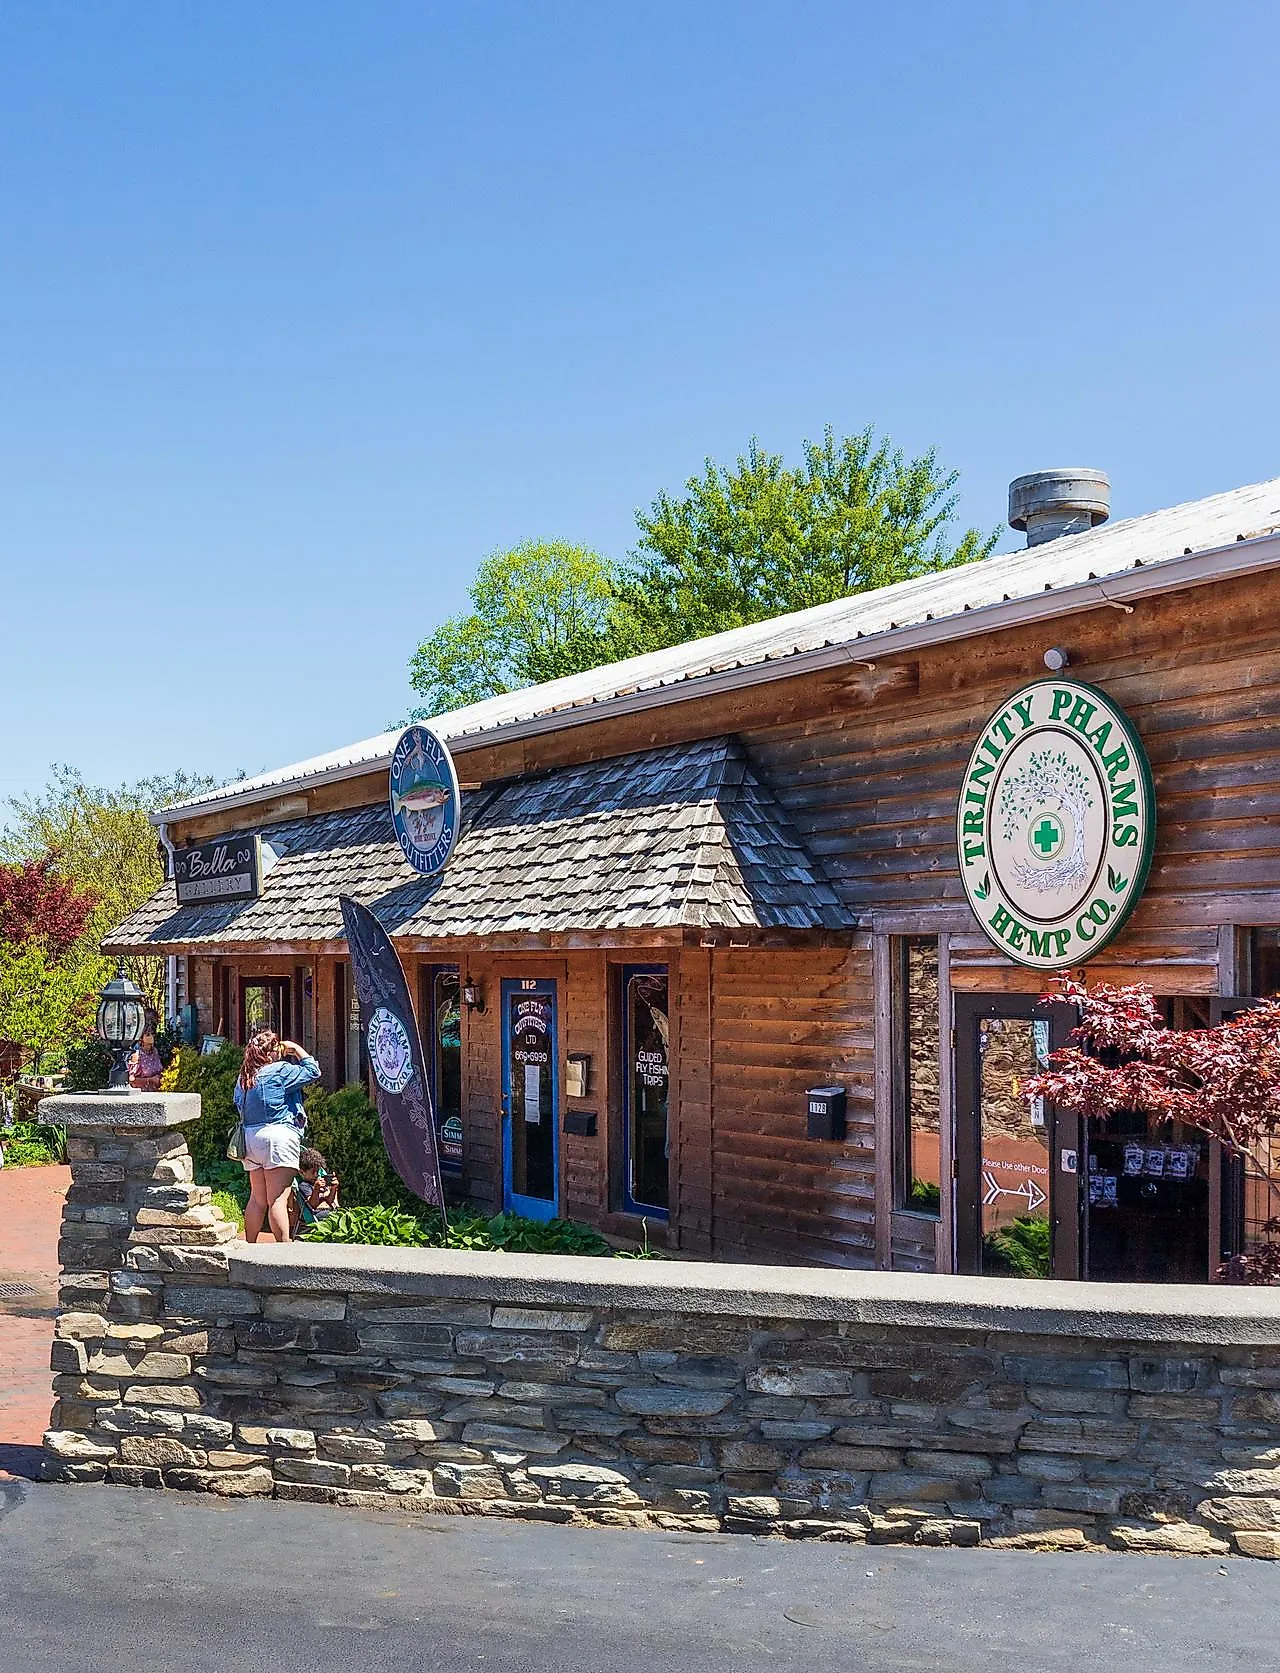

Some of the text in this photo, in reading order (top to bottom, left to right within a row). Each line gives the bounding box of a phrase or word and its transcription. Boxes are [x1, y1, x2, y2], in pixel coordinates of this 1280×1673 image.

[393, 735, 445, 780] ONE FLY
[963, 689, 1139, 867] TRINITY PHARMS
[400, 823, 452, 871] OUTFITTERS
[186, 845, 238, 878] Bella
[987, 897, 1117, 958] HEMP CO.
[521, 980, 537, 990] 112
[517, 1000, 544, 1015] ONE FLY
[514, 1015, 547, 1035] OUTFITTERS
[525, 1034, 537, 1045] LTD
[638, 1050, 663, 1063] GUIDED
[636, 1061, 648, 1073] FLY
[643, 1073, 664, 1087] TRIPS
[443, 1128, 463, 1141] SIMM
[982, 1158, 1049, 1175] Please Use other Door
